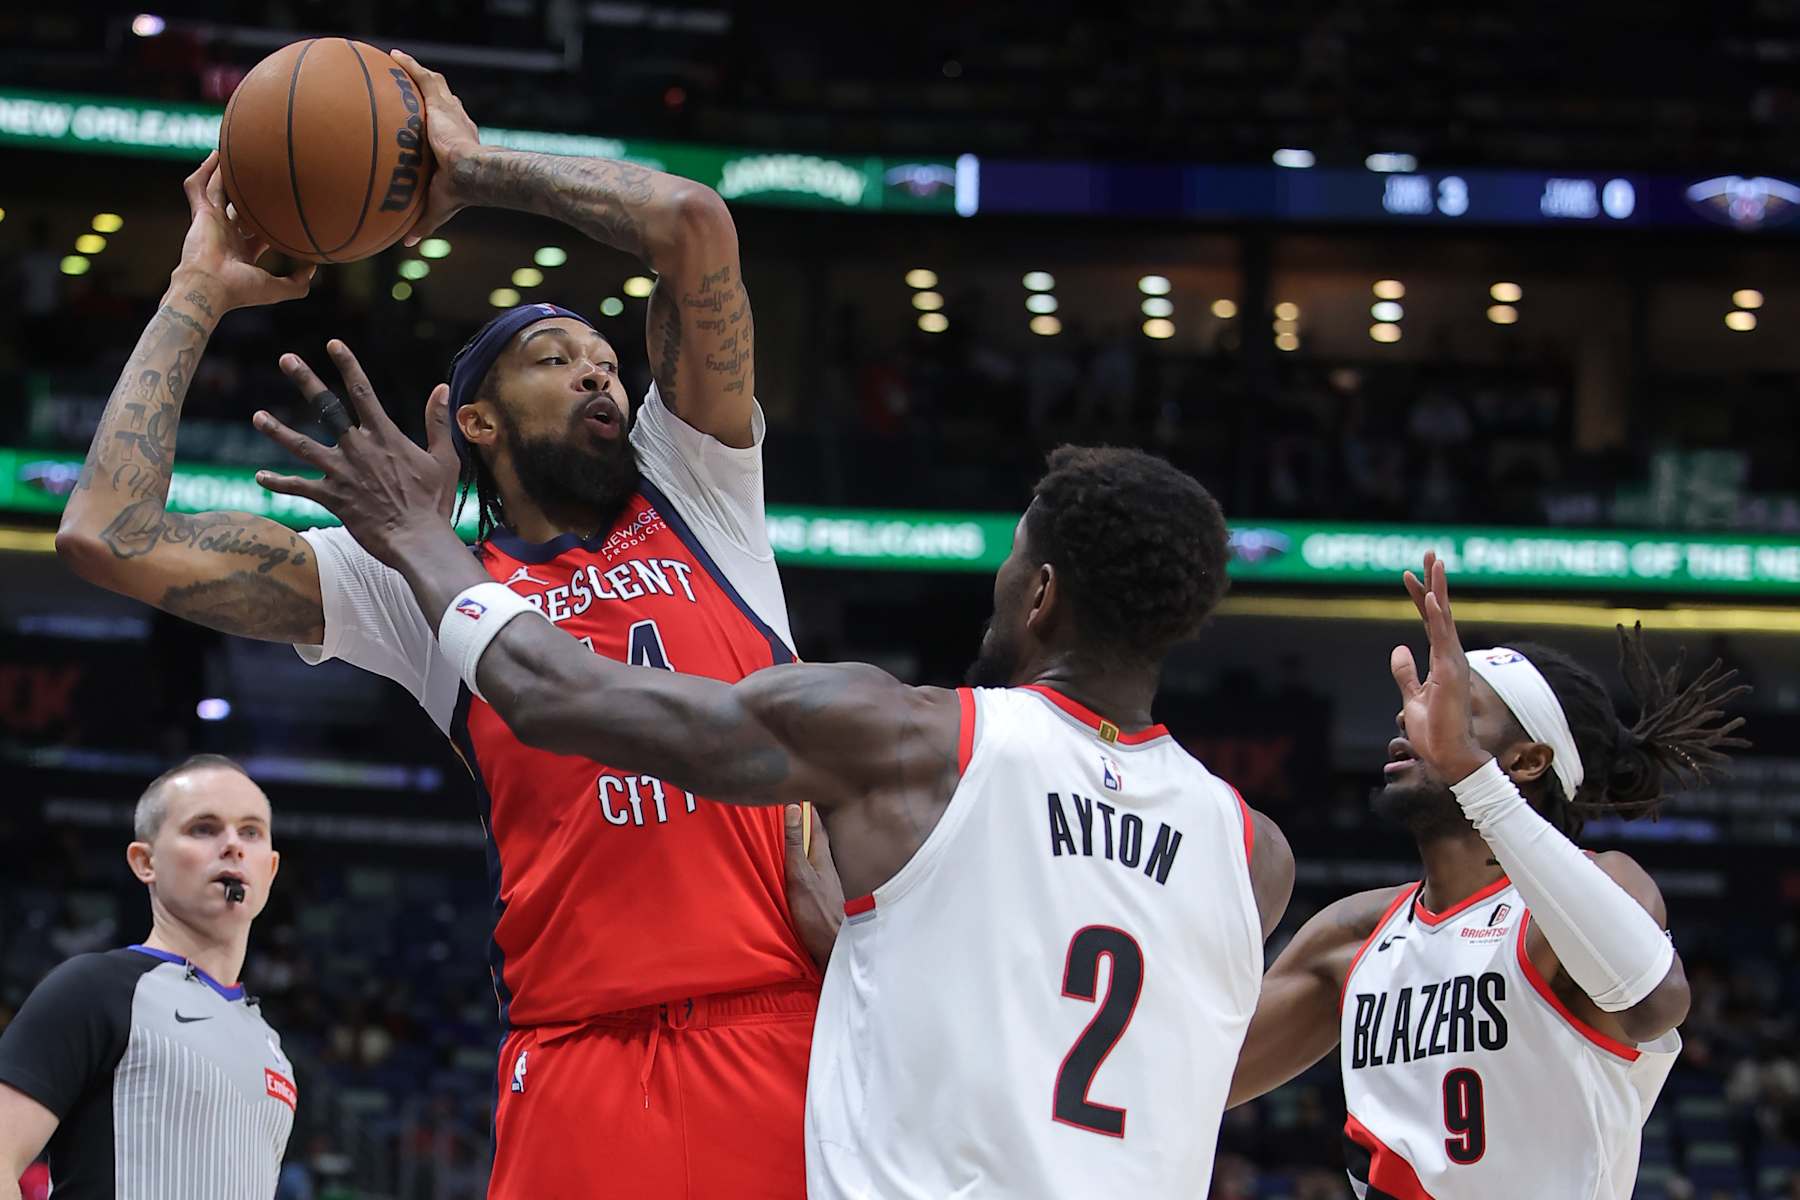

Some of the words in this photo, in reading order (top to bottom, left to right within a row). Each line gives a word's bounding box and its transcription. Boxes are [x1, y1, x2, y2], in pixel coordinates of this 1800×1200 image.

[380, 67, 424, 212] Wilson
[601, 508, 661, 555] NEWAGE
[606, 521, 667, 561] PRODUCTS
[808, 517, 986, 560] PELICANS
[1302, 533, 1464, 574] OFFICIAL
[1463, 537, 1630, 578] PARTNER
[1630, 541, 1684, 578] OF
[1683, 543, 1751, 581] THE
[1047, 793, 1183, 886] AYTON
[1052, 924, 1145, 1139] 2
[1352, 972, 1508, 1070] BLAZERS
[1442, 1067, 1487, 1166] 9
